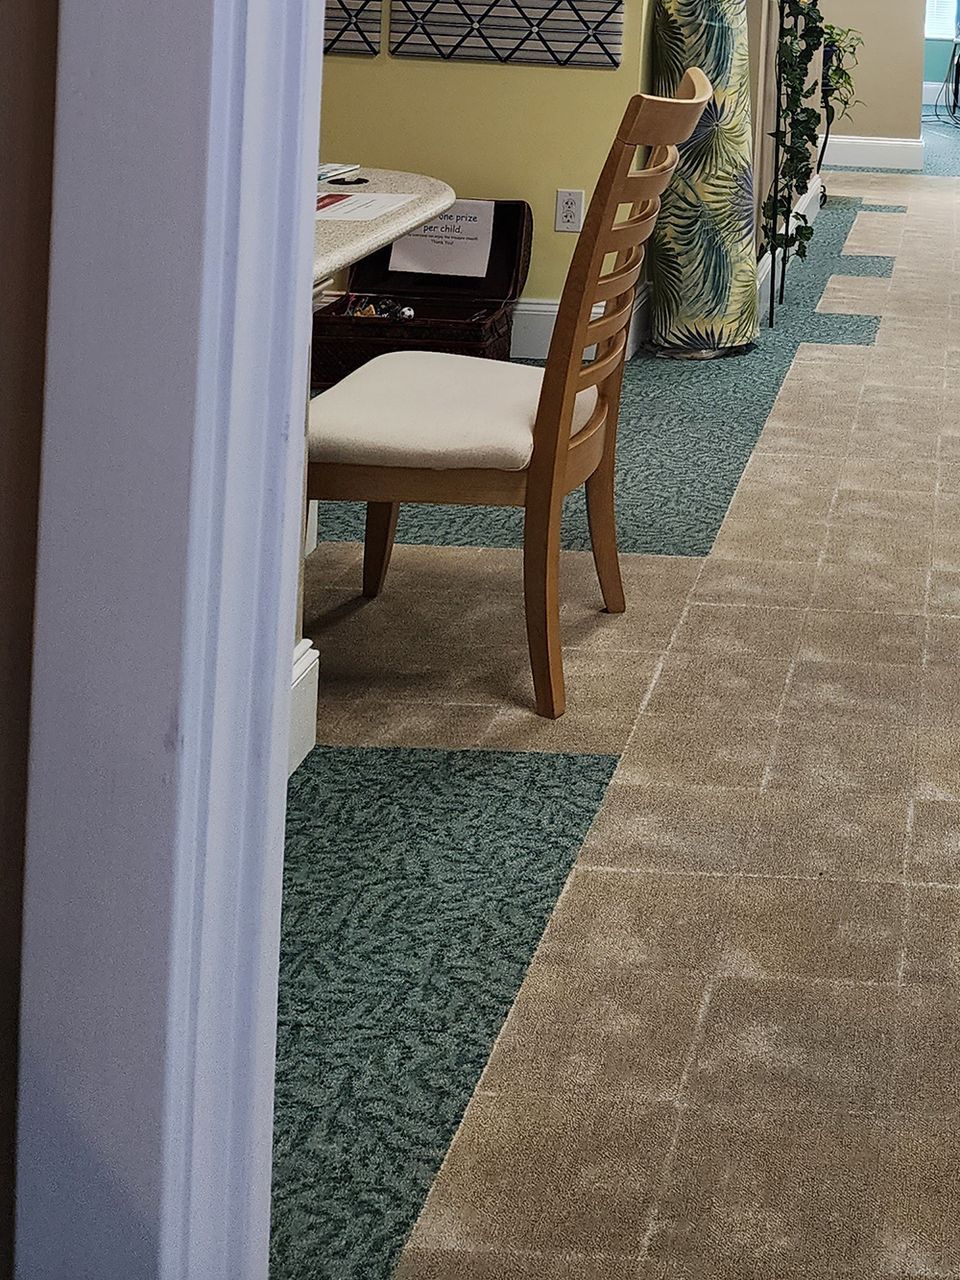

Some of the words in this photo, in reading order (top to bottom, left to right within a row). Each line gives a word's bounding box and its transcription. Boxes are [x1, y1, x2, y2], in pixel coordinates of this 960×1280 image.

[456, 214, 478, 223] prize
[423, 225, 438, 233] per
[440, 224, 462, 234] child.
